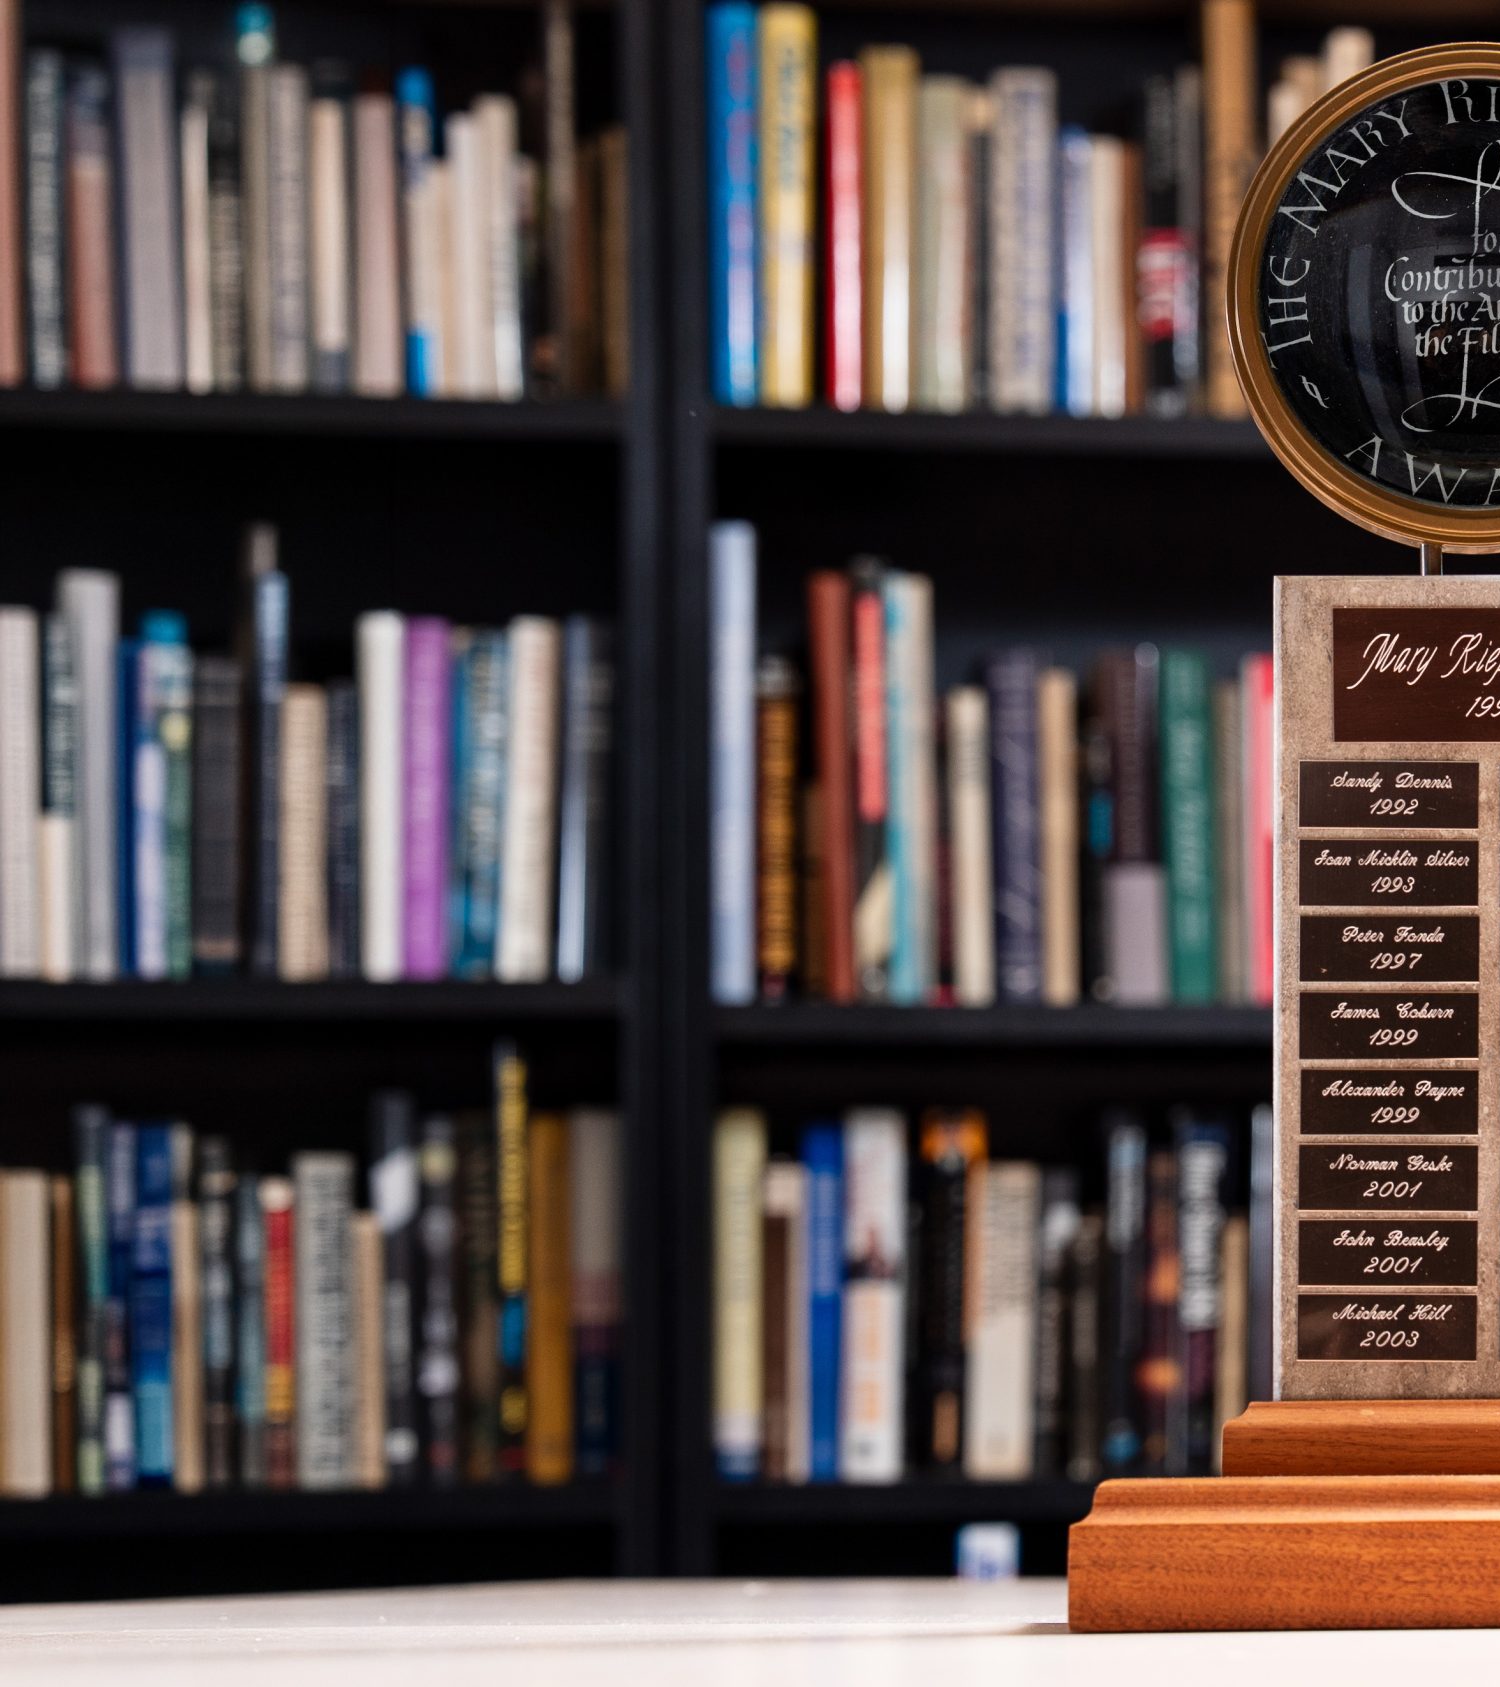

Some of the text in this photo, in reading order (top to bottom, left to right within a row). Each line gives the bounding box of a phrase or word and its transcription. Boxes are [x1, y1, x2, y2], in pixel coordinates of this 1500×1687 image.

[1280, 98, 1413, 237] MARY
[1260, 255, 1313, 369] THE
[1403, 300, 1422, 324] to
[1431, 293, 1469, 323] the
[1415, 328, 1452, 356] the
[1347, 634, 1437, 689] Mary
[1330, 771, 1452, 792] Sandy Dennis
[1370, 799, 1418, 814] 1992
[1315, 850, 1469, 866] Joan Micklin Silver
[1372, 877, 1414, 892] 1993
[1342, 926, 1444, 942] Peter Fonda
[1371, 953, 1422, 969] 1997
[1331, 1002, 1454, 1018] James Coburn
[1370, 1029, 1418, 1045] 1999
[1322, 1080, 1464, 1101] Alexander Payne
[1372, 1107, 1419, 1123] 1999
[1330, 1154, 1452, 1171] Norman Geske
[1363, 1181, 1422, 1197] 2001
[1333, 1230, 1449, 1251] John Beasley
[1364, 1257, 1422, 1273] 2001
[1333, 1304, 1452, 1320] Michael Hill
[1360, 1331, 1419, 1347] 2003
